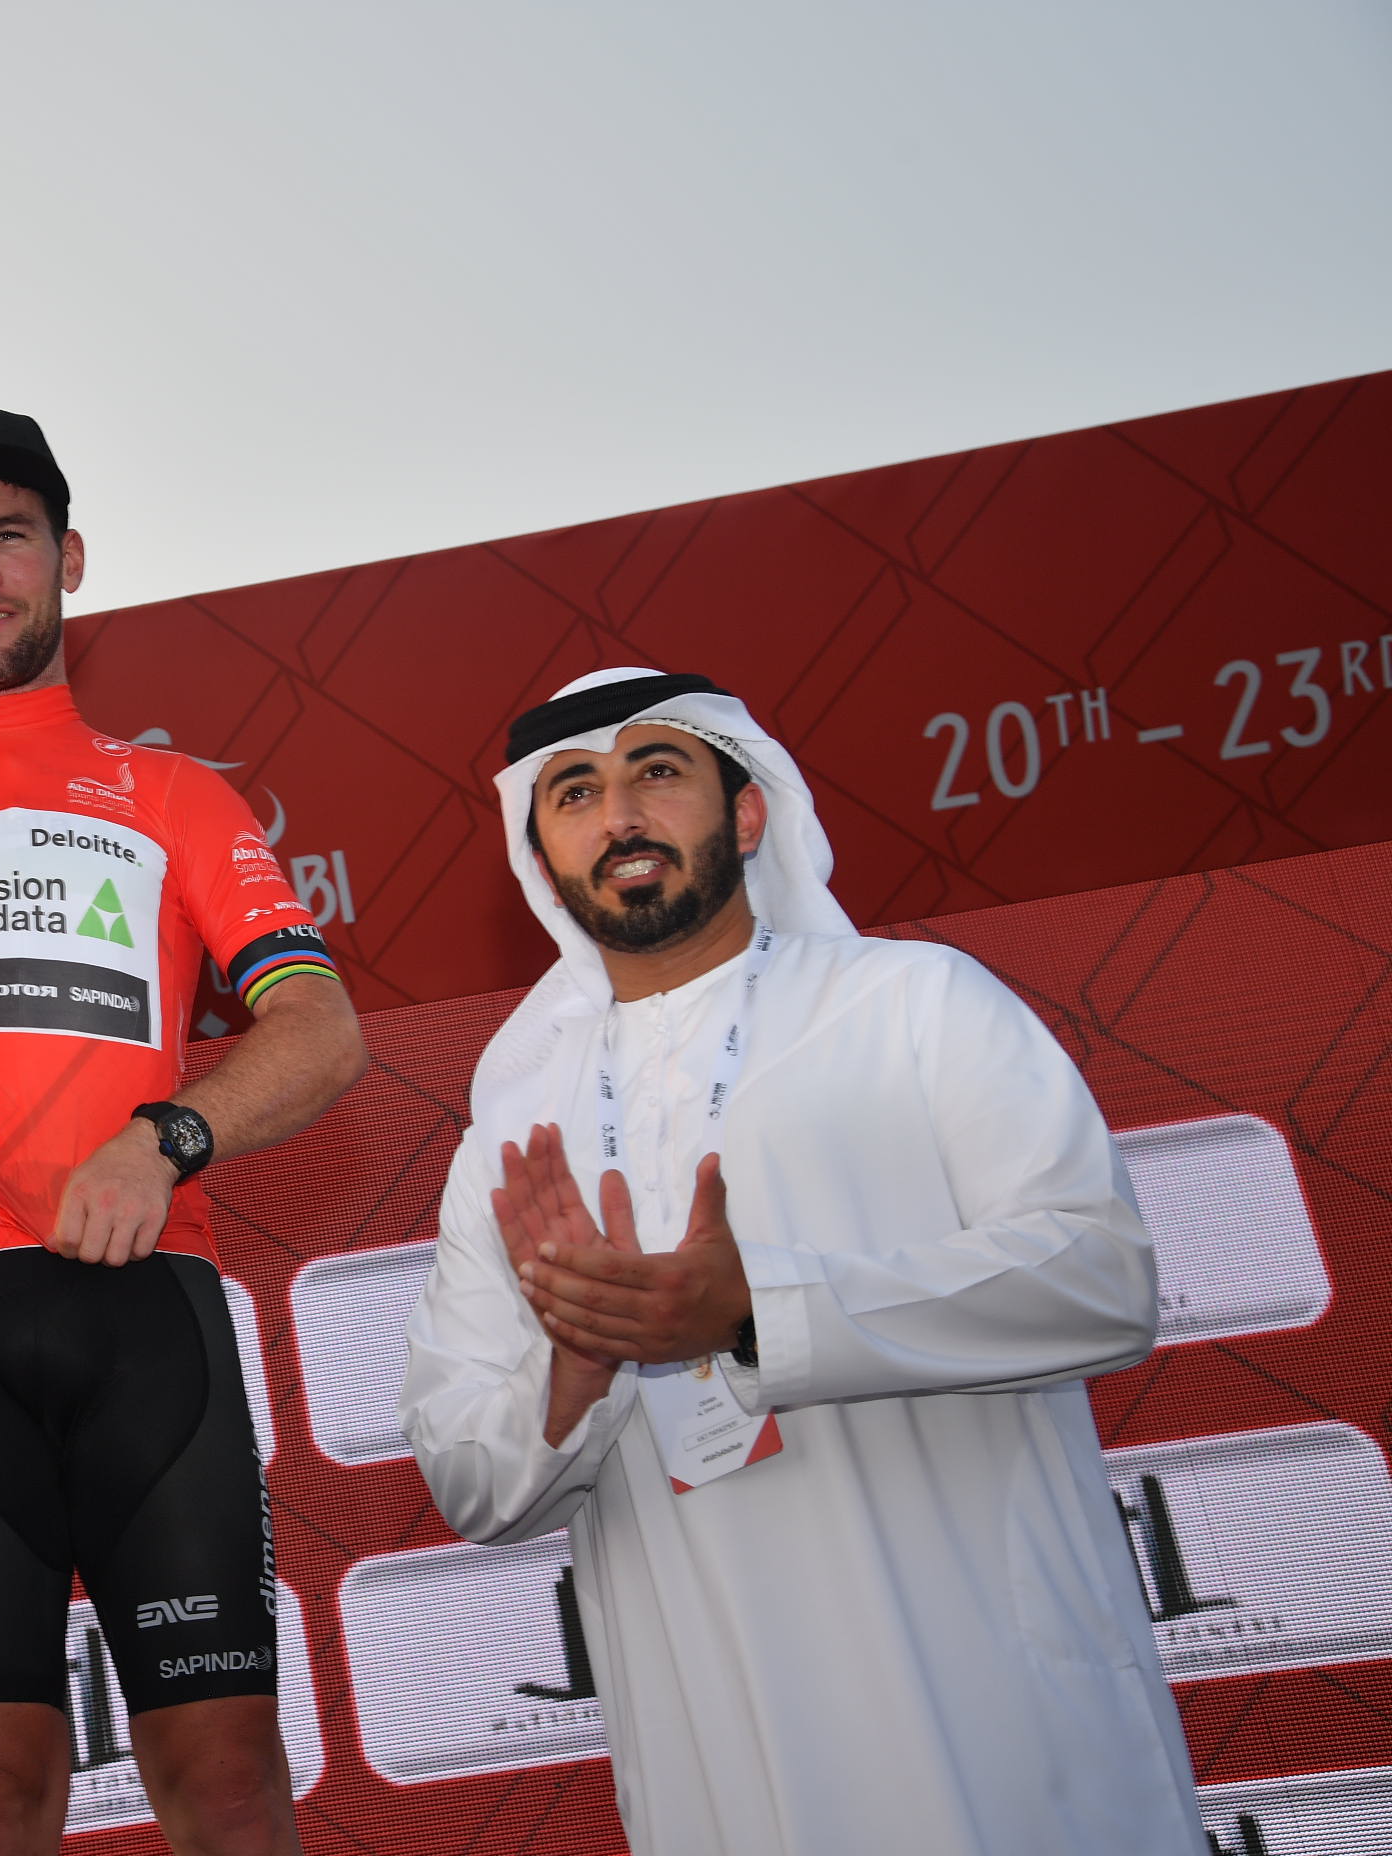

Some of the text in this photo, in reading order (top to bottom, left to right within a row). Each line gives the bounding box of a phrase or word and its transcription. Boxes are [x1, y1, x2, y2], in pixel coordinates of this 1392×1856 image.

[231, 847, 257, 862] Abu
[69, 985, 137, 1013] SAPINDA
[159, 1650, 260, 1679] SAPINDA
